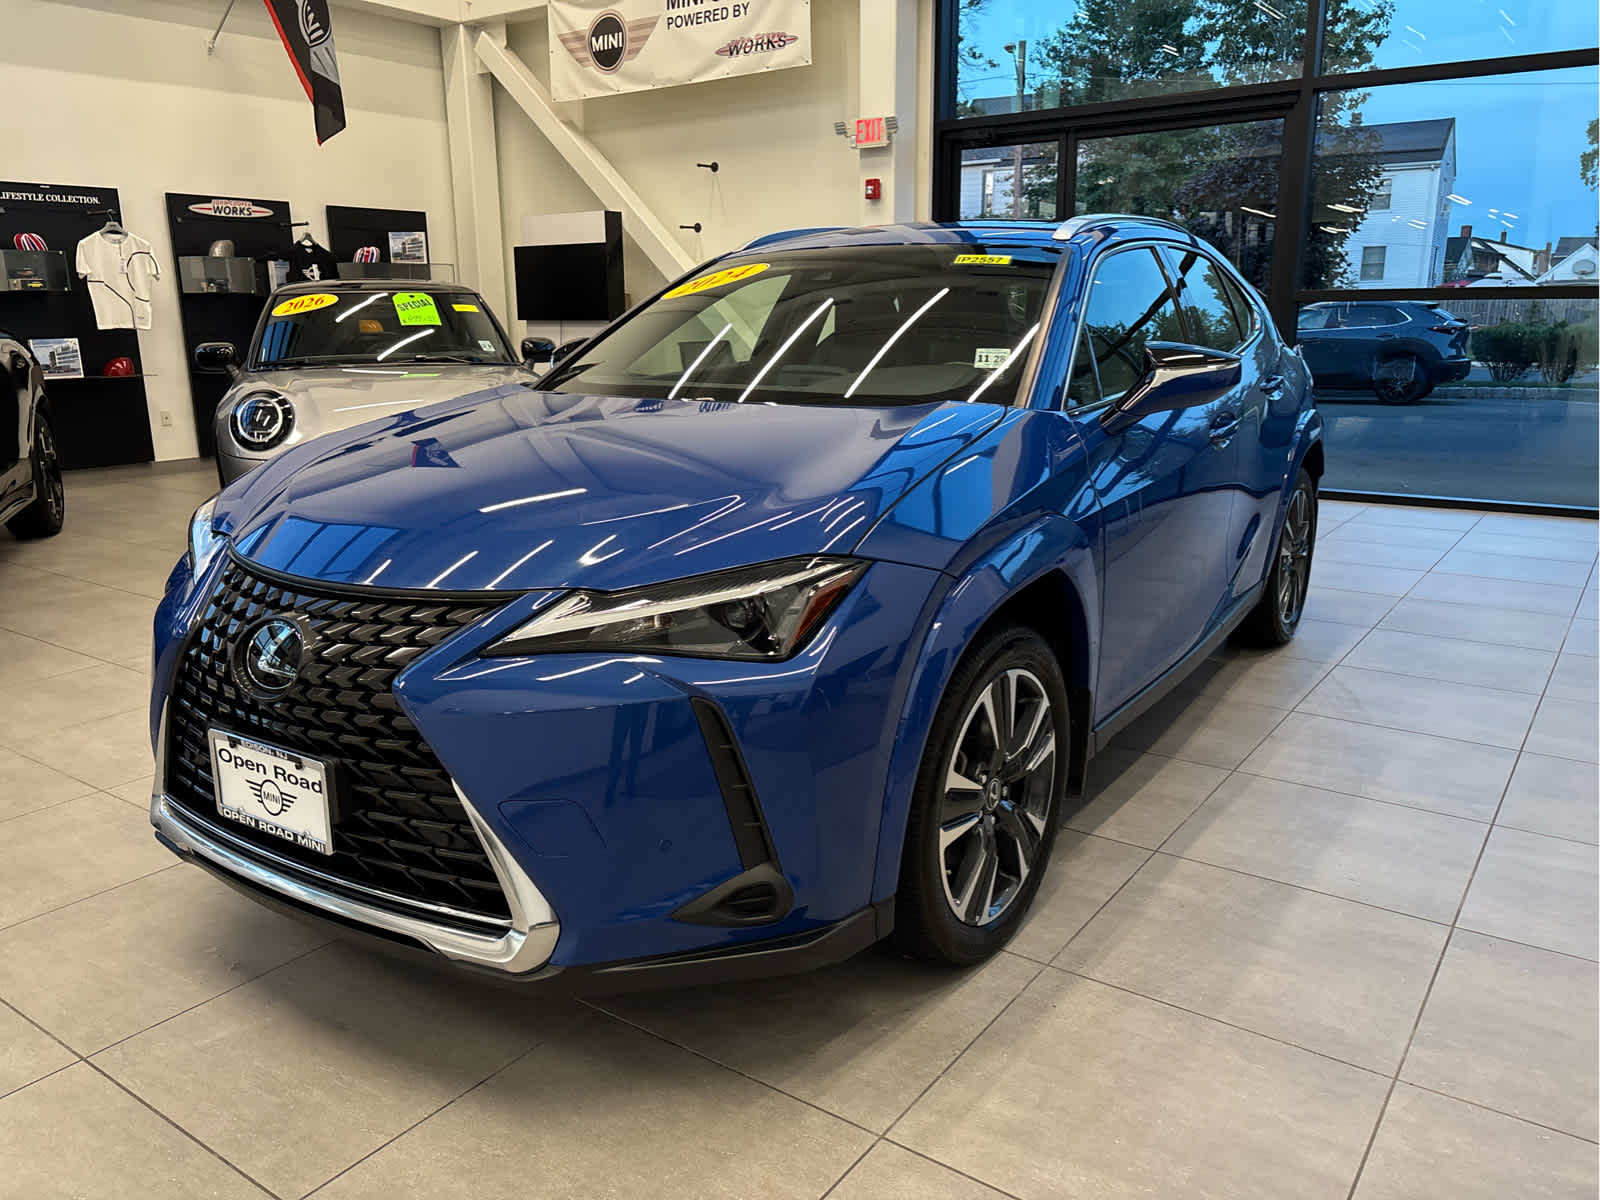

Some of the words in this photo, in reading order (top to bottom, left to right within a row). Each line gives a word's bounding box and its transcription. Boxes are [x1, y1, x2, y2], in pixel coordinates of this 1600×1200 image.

[667, 7, 729, 30] POWERED
[733, 2, 750, 18] BY
[591, 31, 623, 52] MINI
[728, 35, 787, 56] WORKS
[856, 117, 883, 144] EXIT
[46, 194, 101, 204] COLLECTION.
[213, 205, 252, 216] WORKS
[672, 265, 757, 297] 2024
[282, 296, 326, 314] 2026
[397, 298, 433, 312] SPECIAL
[978, 354, 990, 363] 11
[218, 748, 267, 775] Open
[273, 764, 323, 794] Road
[262, 790, 281, 805] MINI
[223, 808, 256, 828] OPEN
[258, 820, 294, 841] ROAD
[297, 835, 327, 853] MINI
